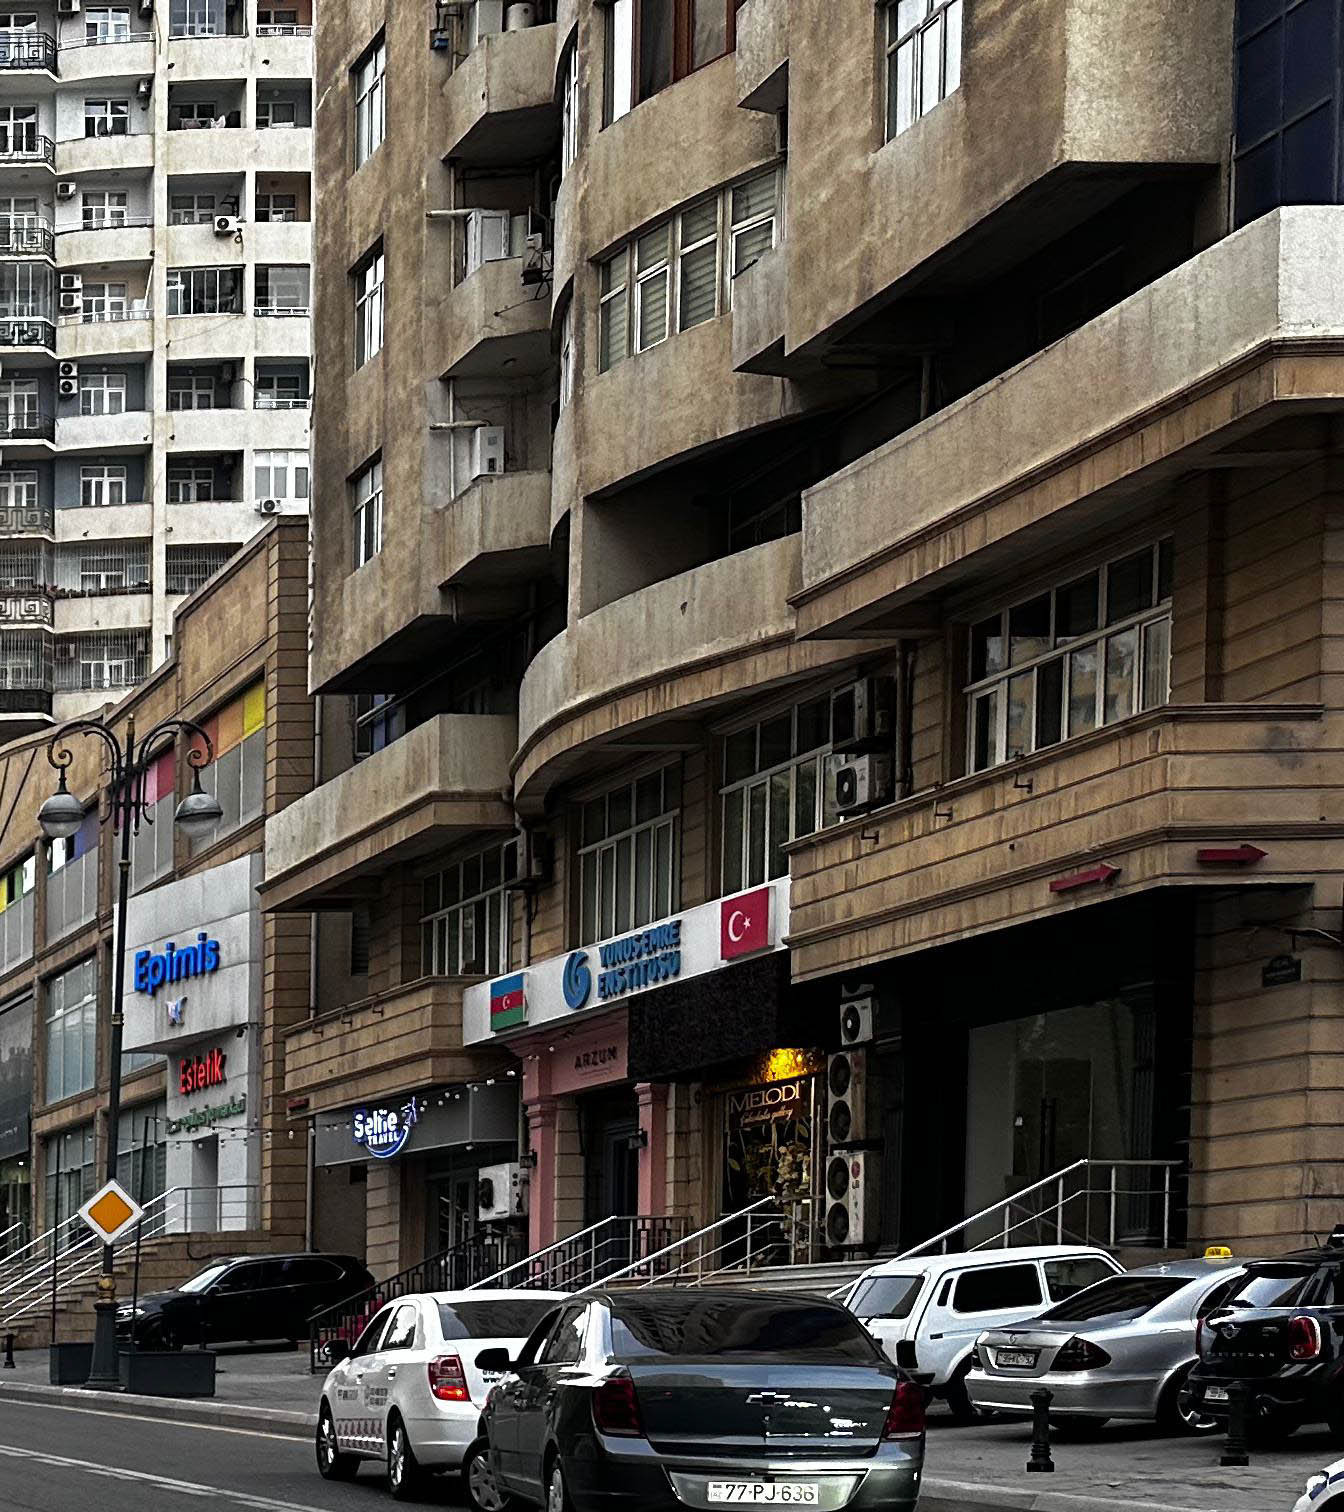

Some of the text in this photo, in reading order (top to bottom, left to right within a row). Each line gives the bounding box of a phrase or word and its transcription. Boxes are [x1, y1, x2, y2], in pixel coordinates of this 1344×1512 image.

[599, 920, 681, 968] YUNUS EMRE
[134, 932, 220, 996] Epimis
[354, 1109, 398, 1138] Selfie
[725, 1484, 815, 1502] 77-PJ-636
